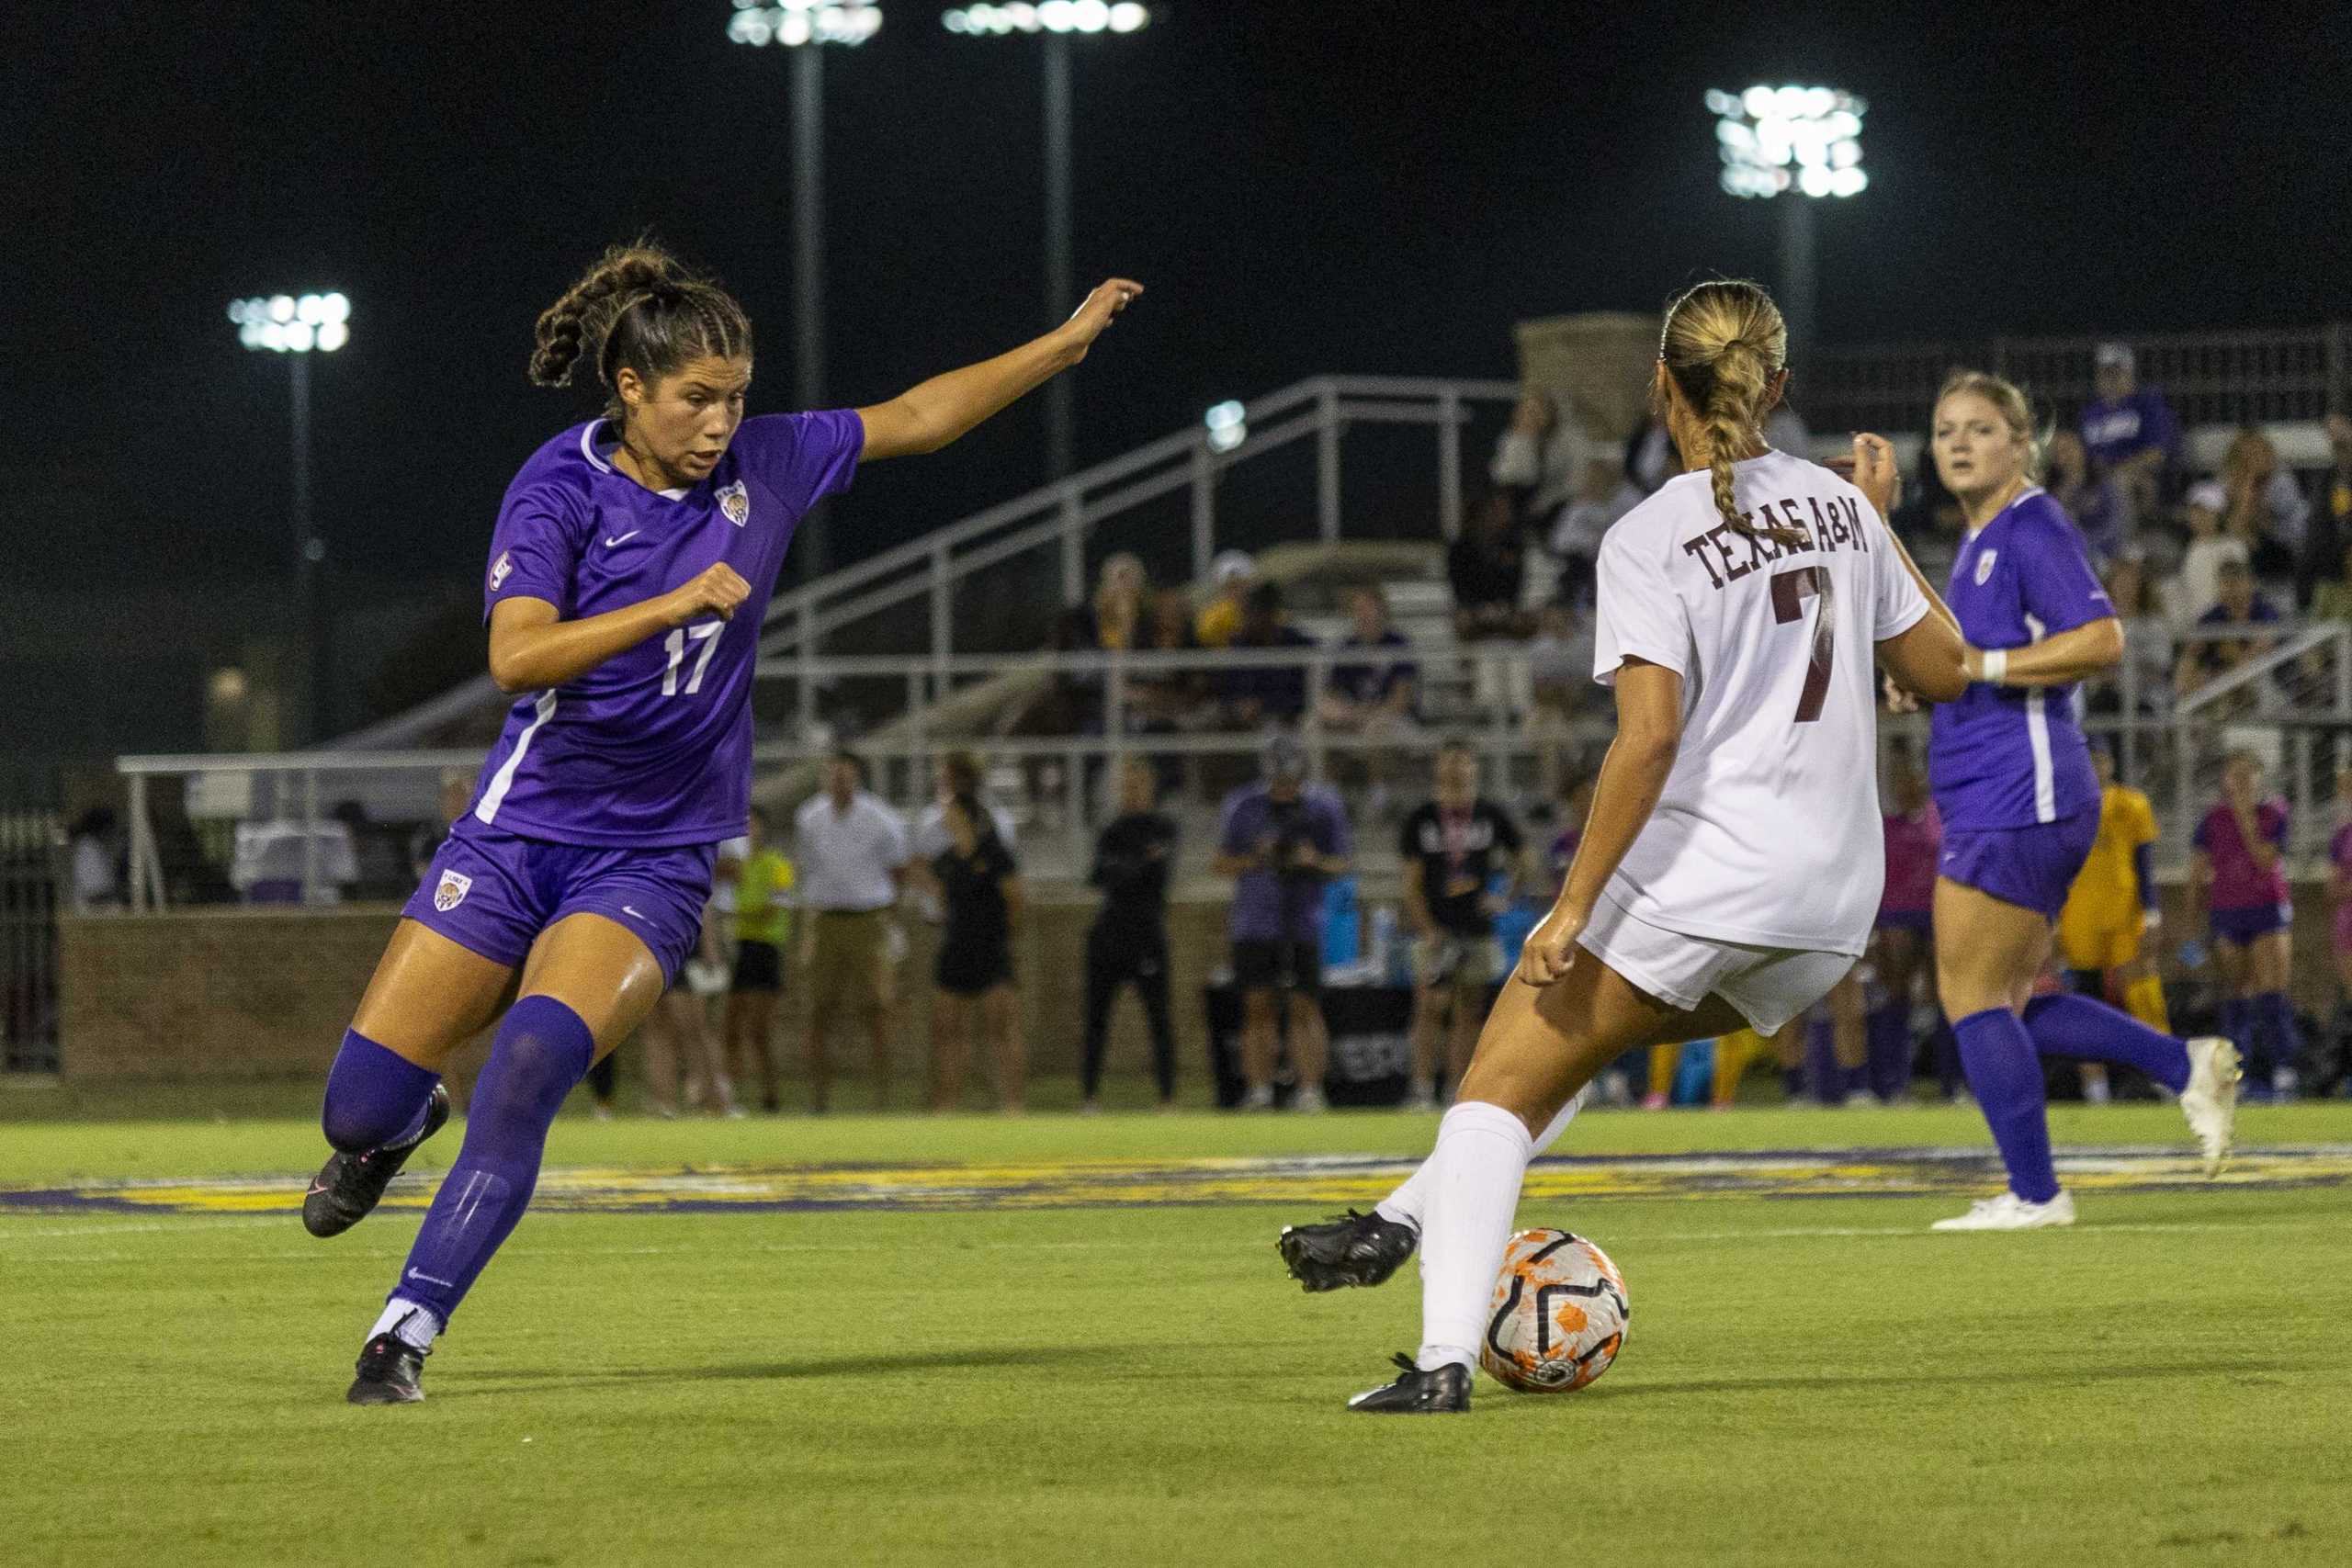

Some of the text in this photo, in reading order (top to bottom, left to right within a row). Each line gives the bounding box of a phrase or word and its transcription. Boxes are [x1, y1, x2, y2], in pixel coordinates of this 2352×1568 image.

[1683, 496, 1870, 590] TEXAS A&M
[662, 620, 726, 696] 17
[1770, 566, 1835, 723] 7
